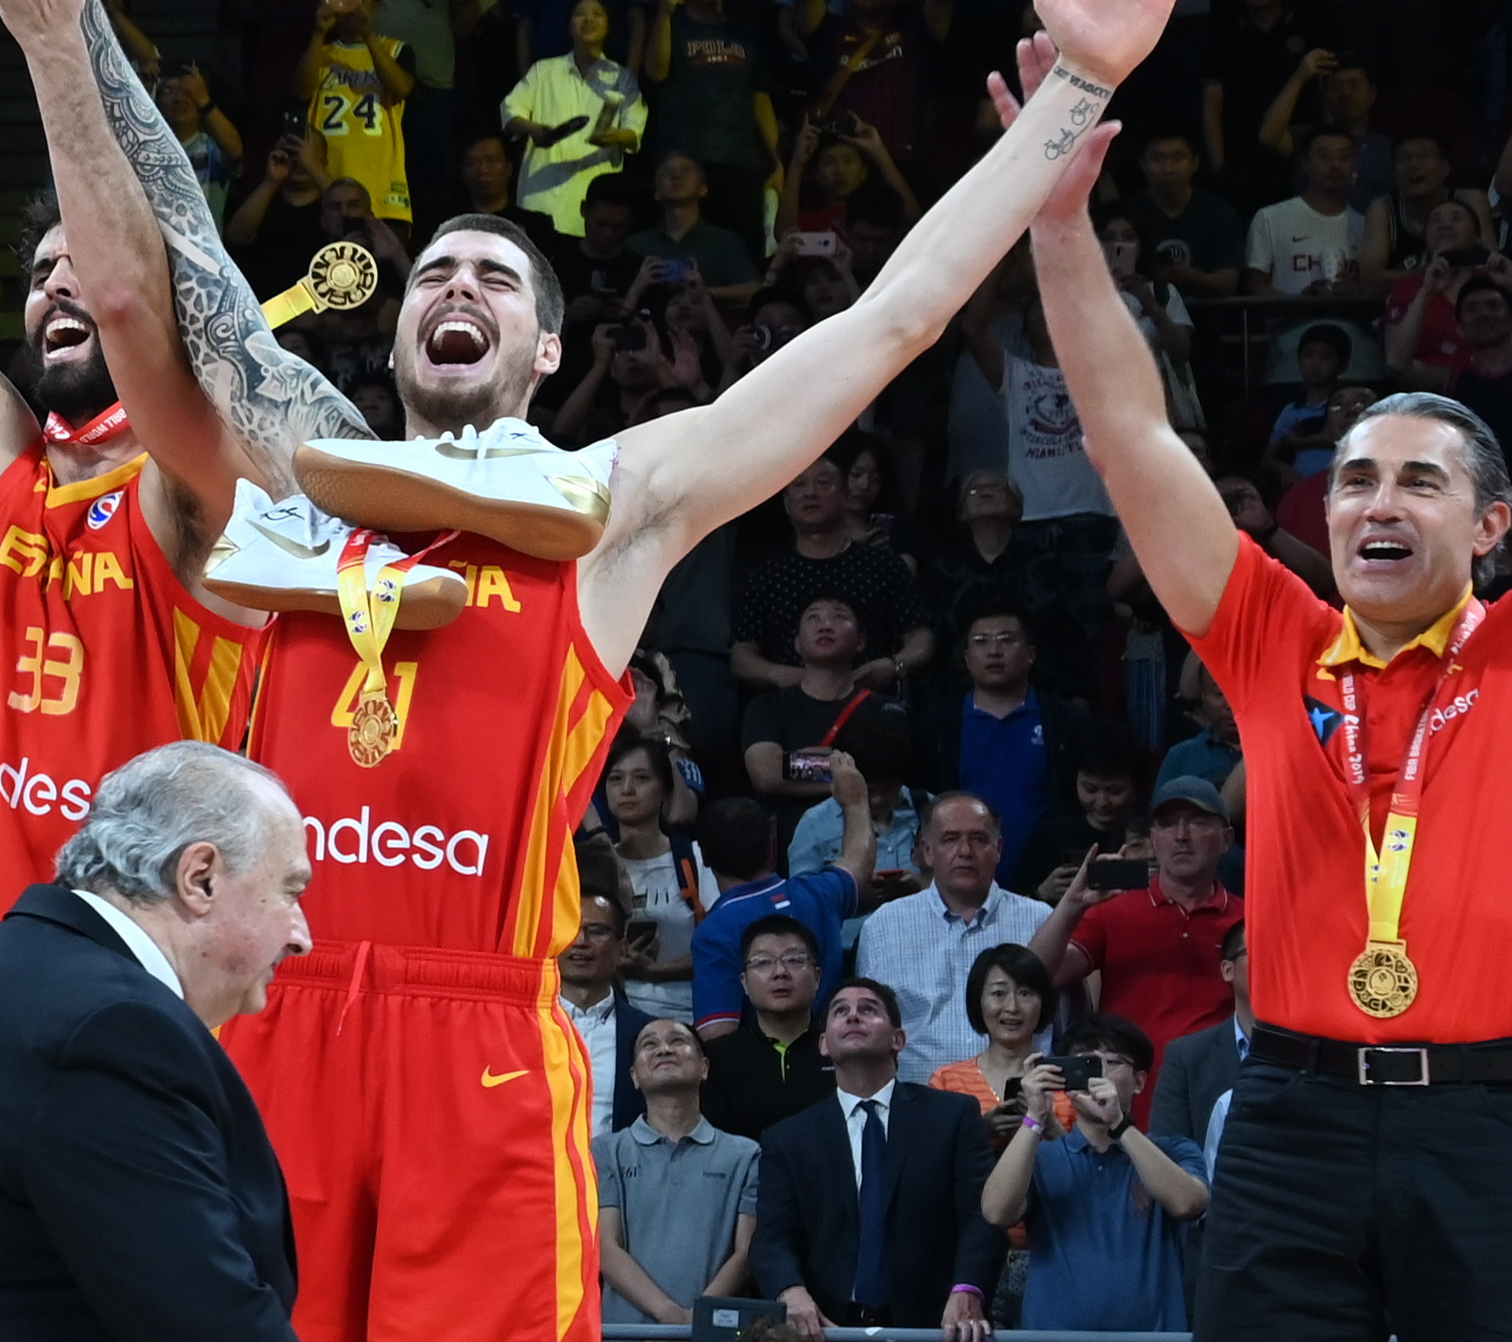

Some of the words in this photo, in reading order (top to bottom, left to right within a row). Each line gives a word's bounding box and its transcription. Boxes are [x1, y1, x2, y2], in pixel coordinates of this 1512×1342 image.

[323, 93, 384, 136] 24
[8, 627, 83, 715] 33
[331, 661, 418, 750] 41
[1344, 714, 1360, 752] China
[304, 806, 488, 877] ndesa
